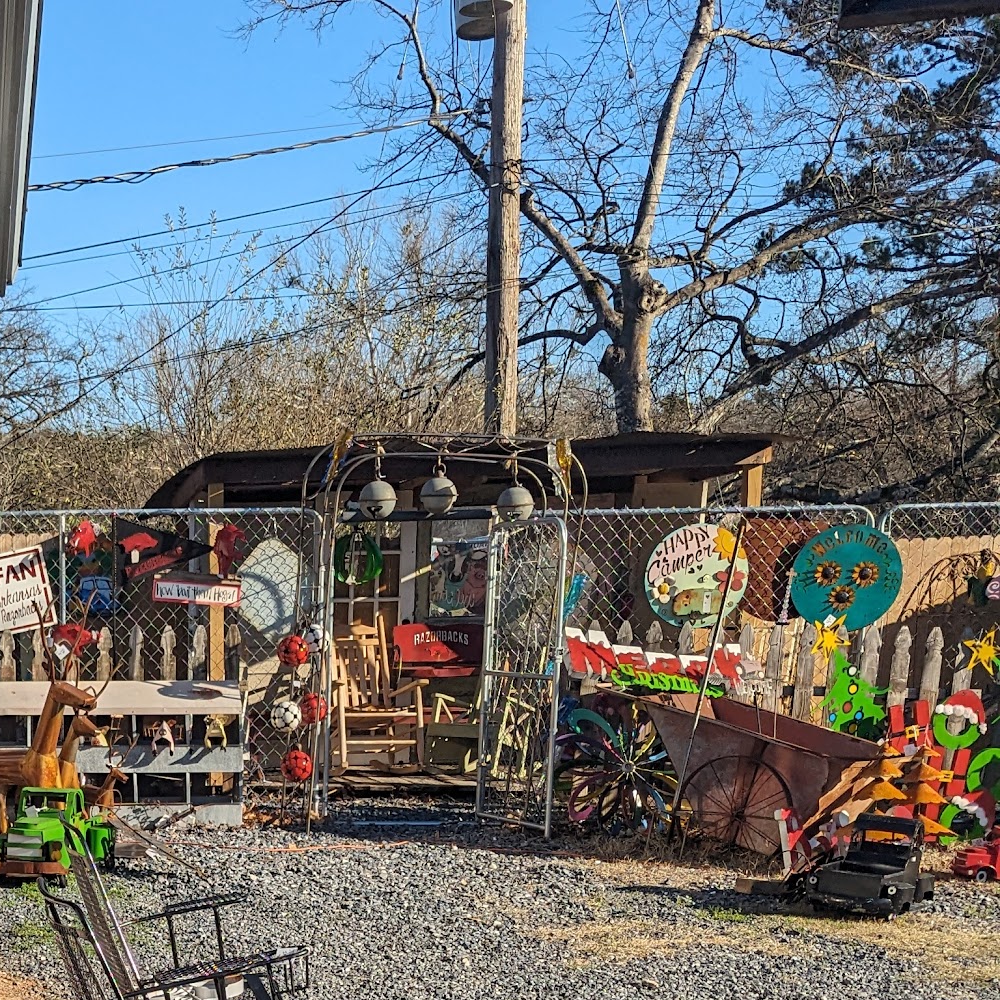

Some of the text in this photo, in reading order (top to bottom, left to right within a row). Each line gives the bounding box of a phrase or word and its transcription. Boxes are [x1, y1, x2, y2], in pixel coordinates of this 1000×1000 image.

[663, 525, 710, 555] HAPPY
[647, 544, 712, 585] Camper
[414, 630, 469, 646] RAZORBACKS
